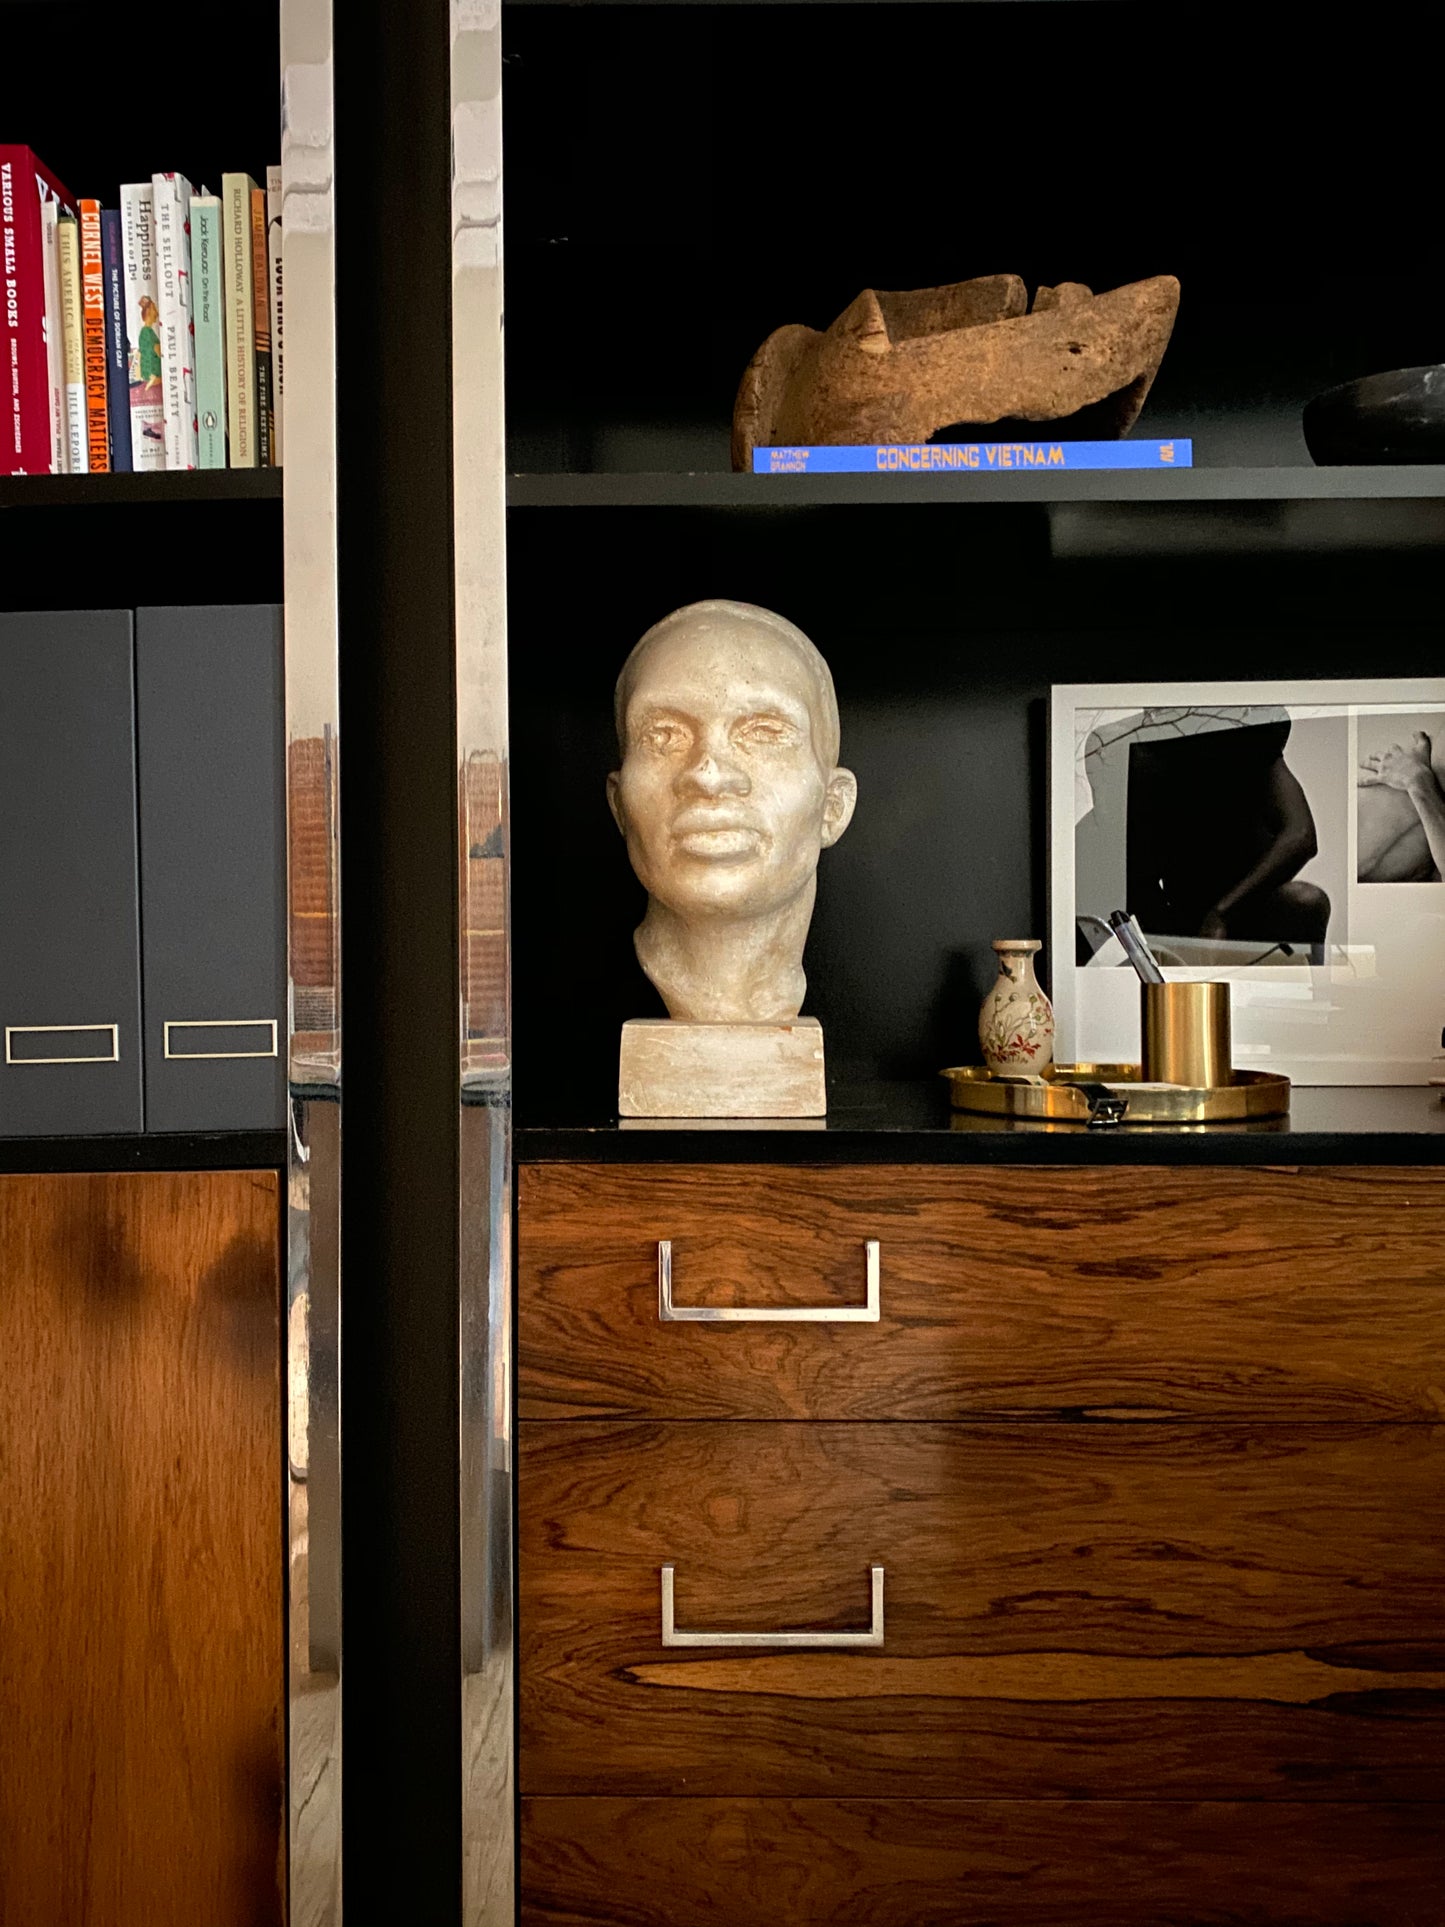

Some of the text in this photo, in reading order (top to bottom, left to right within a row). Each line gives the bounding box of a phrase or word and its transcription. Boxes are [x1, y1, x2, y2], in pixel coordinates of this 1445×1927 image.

[1, 162, 18, 328] VARIOUS SMALL BOOKS
[61, 232, 71, 264] THIS
[81, 212, 104, 310] CORNEL WEST
[129, 250, 135, 260] OF
[137, 200, 153, 281] Happiness
[161, 204, 174, 298] THE SELLOUT
[200, 215, 209, 274] Jack Kerouac
[233, 188, 244, 293] RICHARD HOLLOWAY
[253, 209, 265, 308] JAMES BALDWIN
[63, 270, 74, 329] AMERICA
[111, 269, 119, 281] THE
[112, 282, 120, 310] PICTURE
[202, 278, 209, 289] On
[202, 289, 210, 304] the
[113, 311, 120, 321] OF
[114, 322, 122, 349] DORIAN
[86, 318, 108, 472] DEMOCRACY MATTERS
[167, 326, 180, 417] PAUL BEATTY
[236, 298, 247, 457] A LITTLE HISTORY OF RELIGION
[68, 391, 80, 473] JILL LEPORE
[876, 444, 1066, 470] CONCERNING VIETNAM
